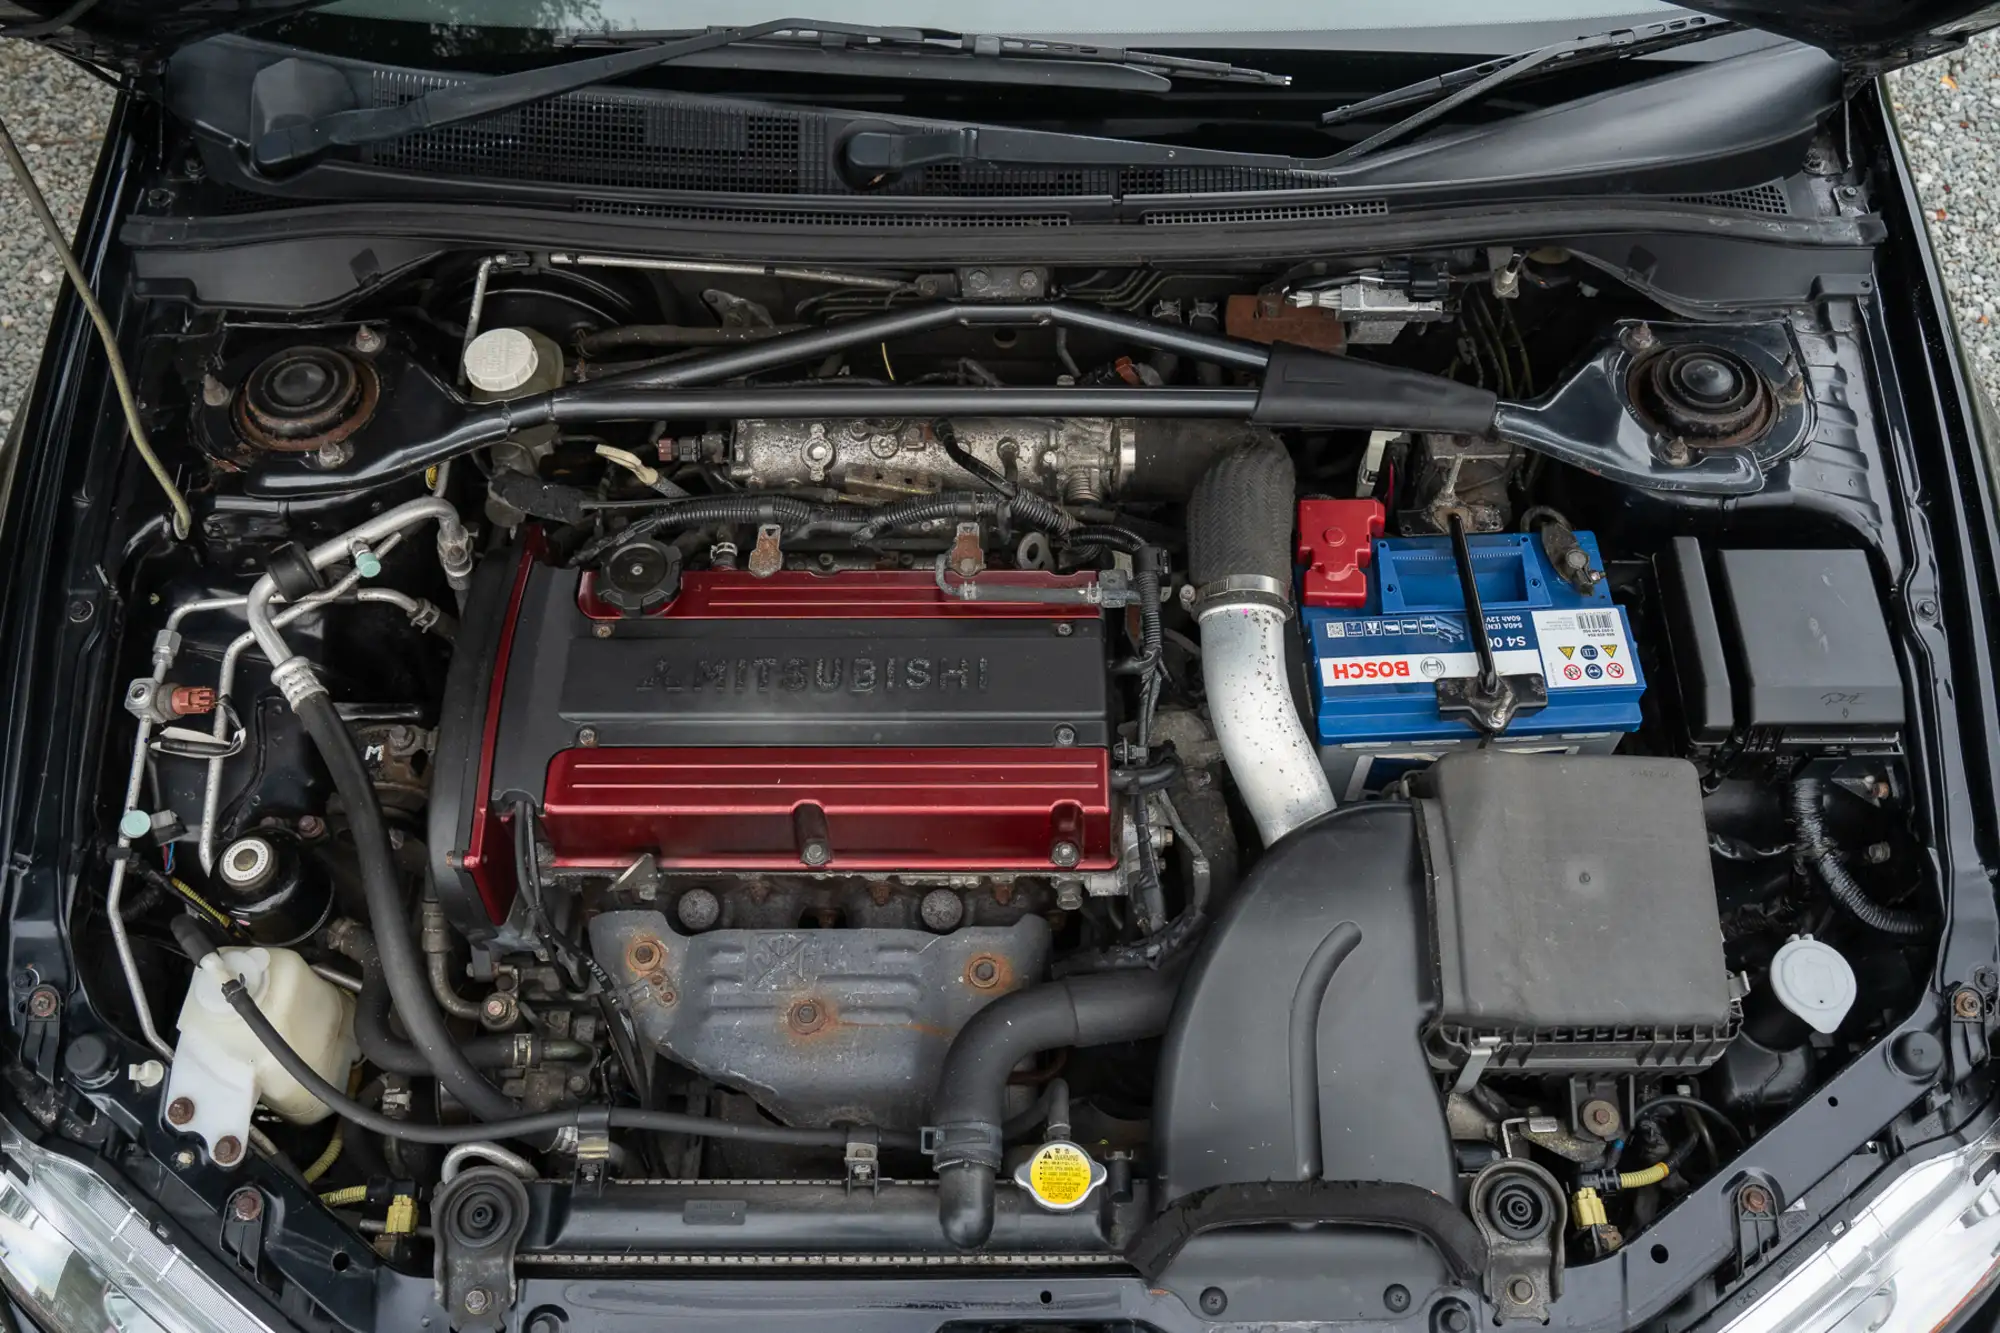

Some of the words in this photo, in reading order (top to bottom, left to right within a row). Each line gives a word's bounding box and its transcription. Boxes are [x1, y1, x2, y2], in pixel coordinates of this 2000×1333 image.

[1506, 636, 1526, 647] S4
[692, 657, 989, 693] MITSUBISHI
[1333, 661, 1410, 680] BOSCH
